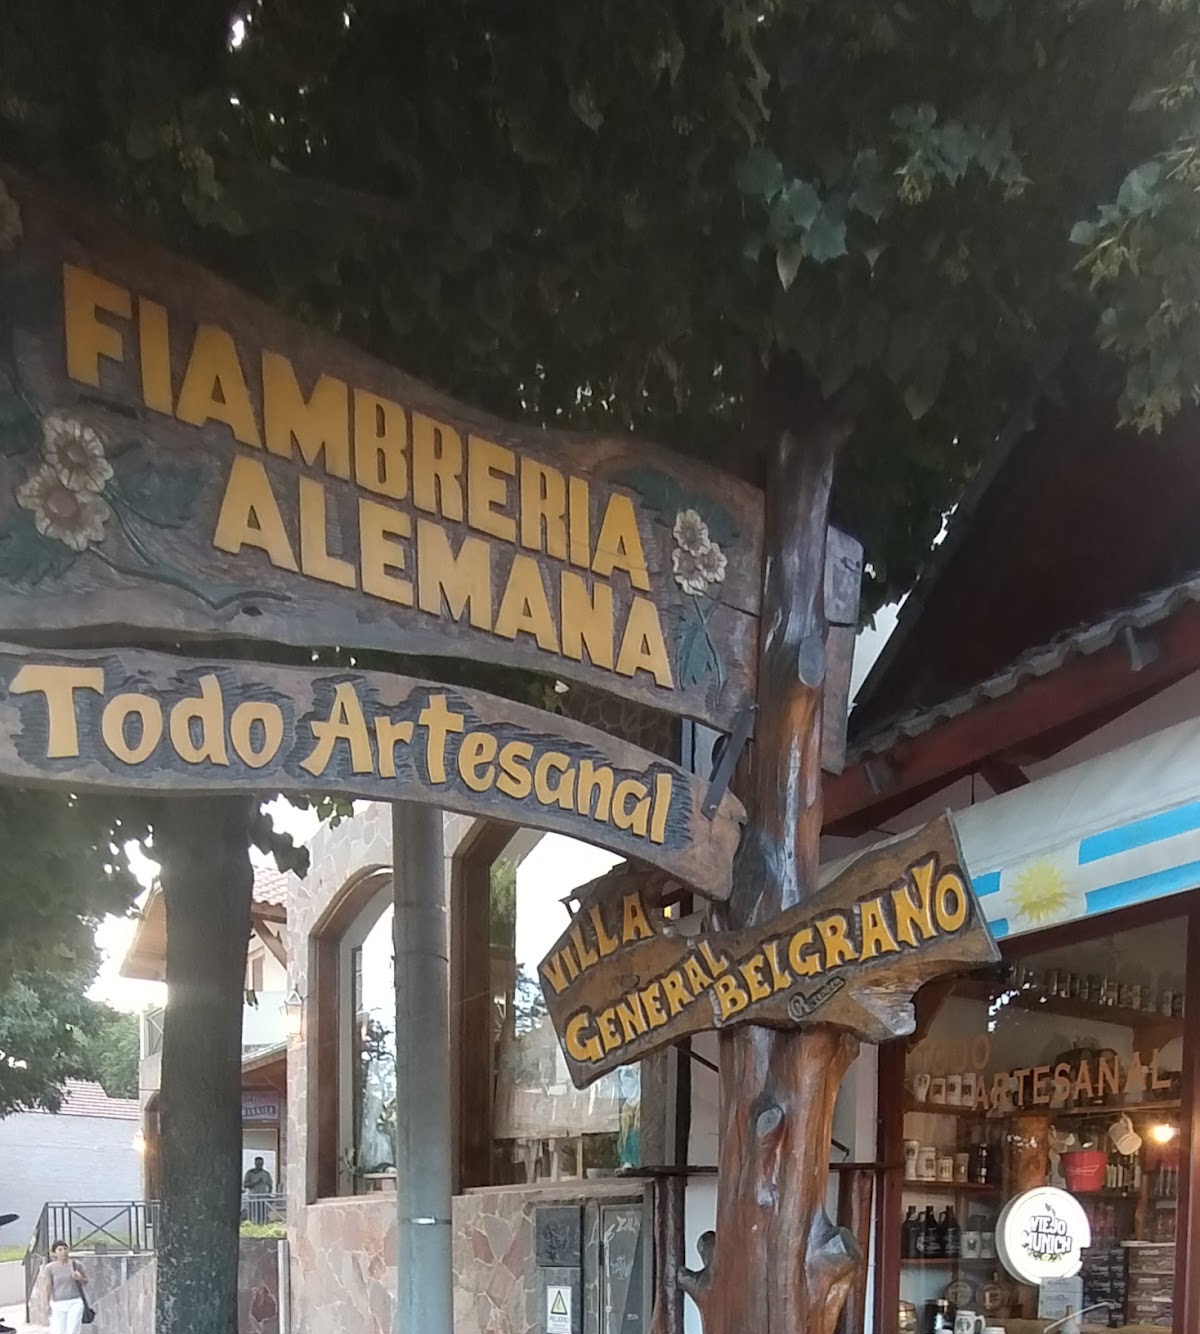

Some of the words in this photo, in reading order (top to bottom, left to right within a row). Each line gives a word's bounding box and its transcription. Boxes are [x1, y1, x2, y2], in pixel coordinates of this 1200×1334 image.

[63, 263, 651, 591] FIAMBRERIA
[213, 455, 674, 690] ALEMANA
[9, 664, 284, 767] Todo
[300, 682, 673, 844] Artesanal
[541, 892, 656, 995] VILLA
[565, 938, 727, 1063] GENERAL
[714, 858, 967, 1022] BELGRANO
[973, 1048, 1172, 1111] ARTESANAL
[1025, 1232, 1072, 1254] MUNICH
[1030, 1215, 1067, 1236] VIEJO
